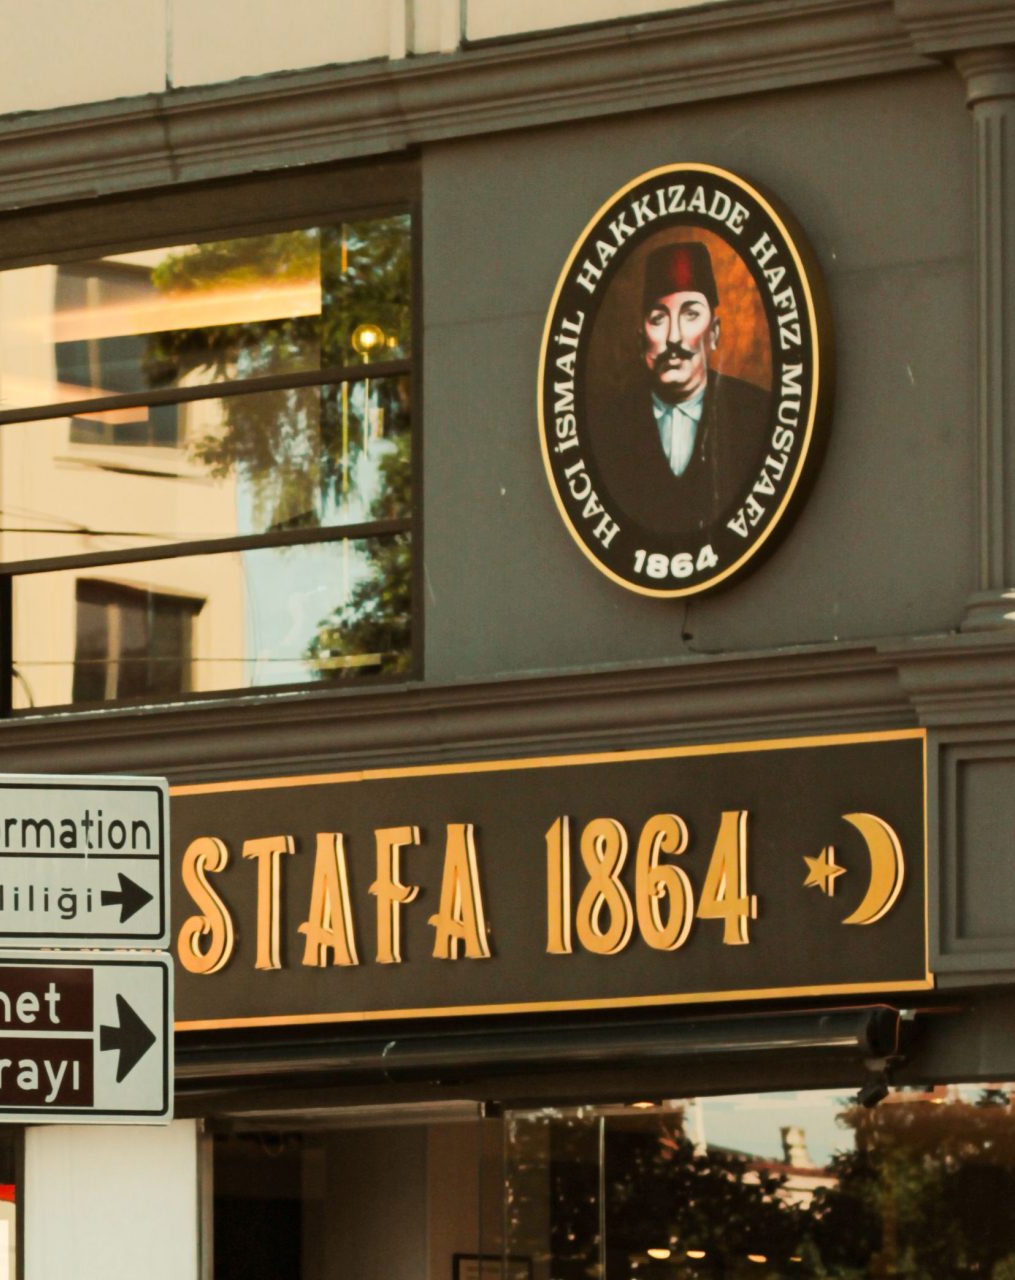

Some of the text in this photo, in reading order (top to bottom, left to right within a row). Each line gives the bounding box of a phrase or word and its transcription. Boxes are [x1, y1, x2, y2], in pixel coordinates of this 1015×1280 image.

[554, 184, 803, 549] HACI İSMAİL HAKKIZADE HAFIZ MUSTAFA
[633, 544, 719, 578] 1864
[544, 810, 758, 956] 1864
